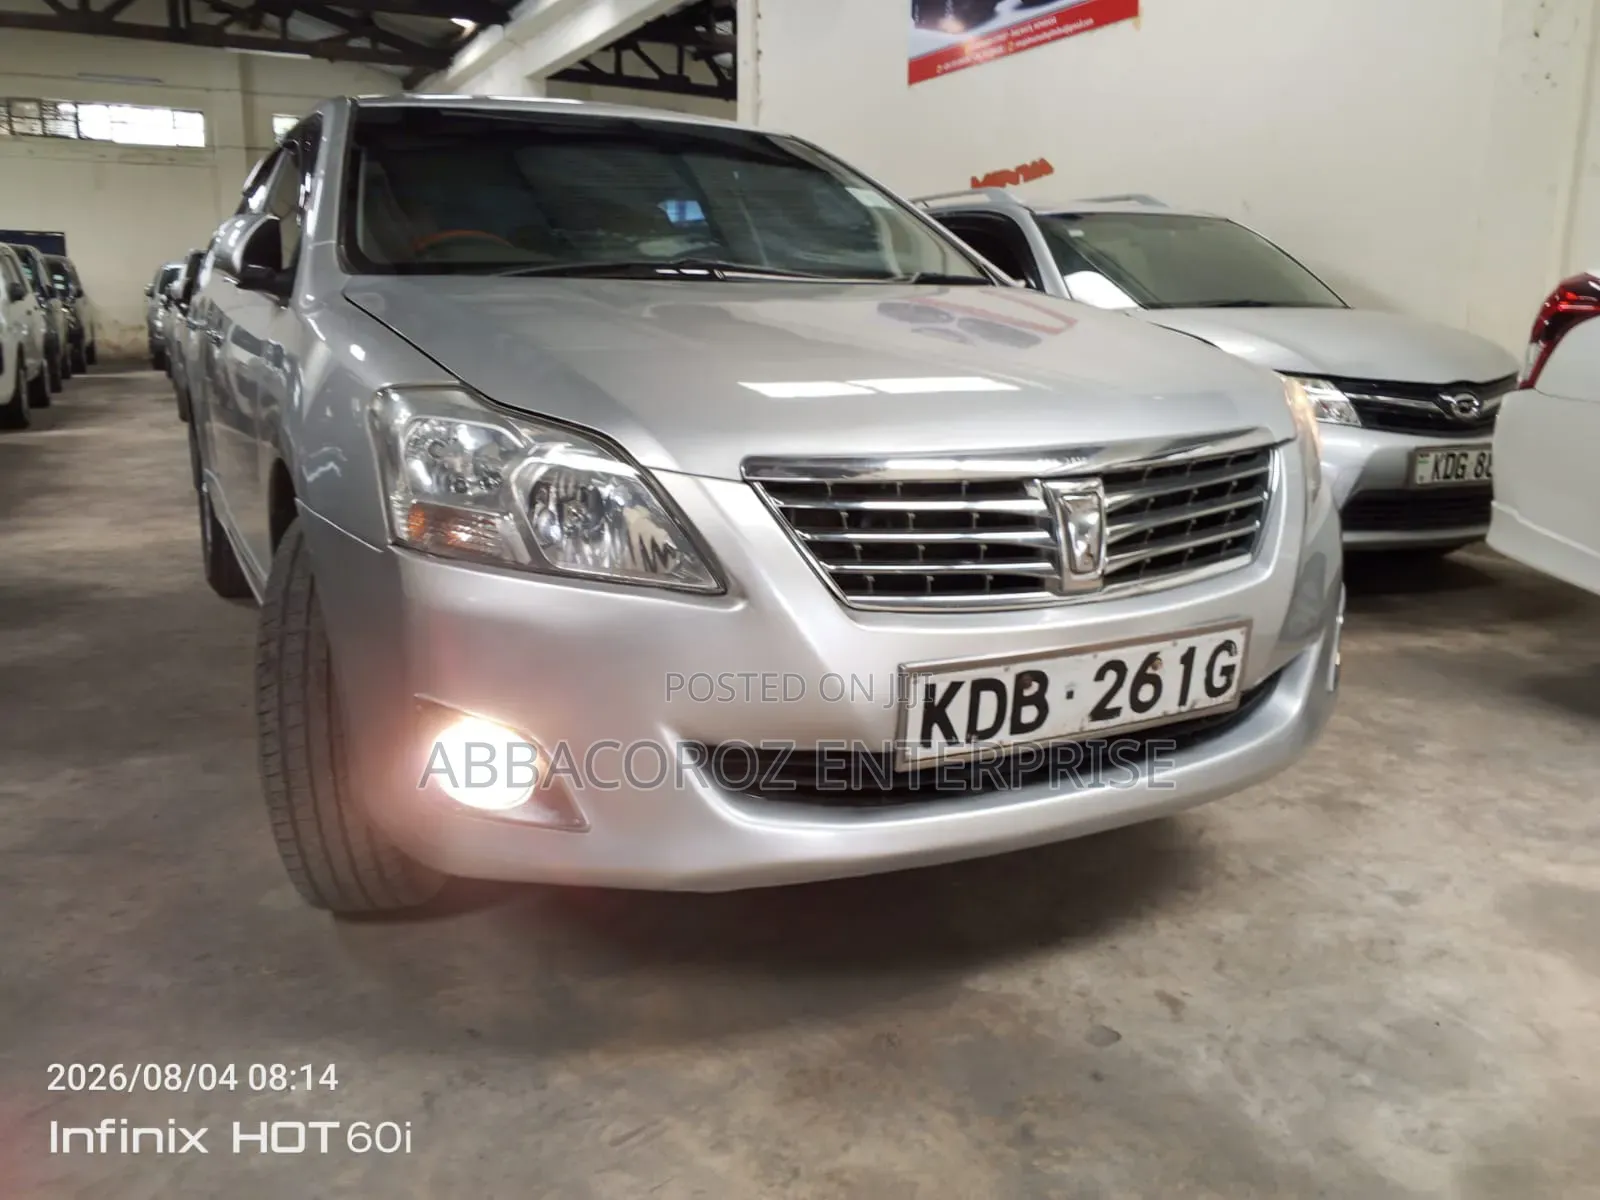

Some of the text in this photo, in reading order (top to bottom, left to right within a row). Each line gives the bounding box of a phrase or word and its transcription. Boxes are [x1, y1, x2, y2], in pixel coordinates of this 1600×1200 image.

[1432, 452, 1468, 480] KDG
[920, 639, 1238, 748] KDB 261G
